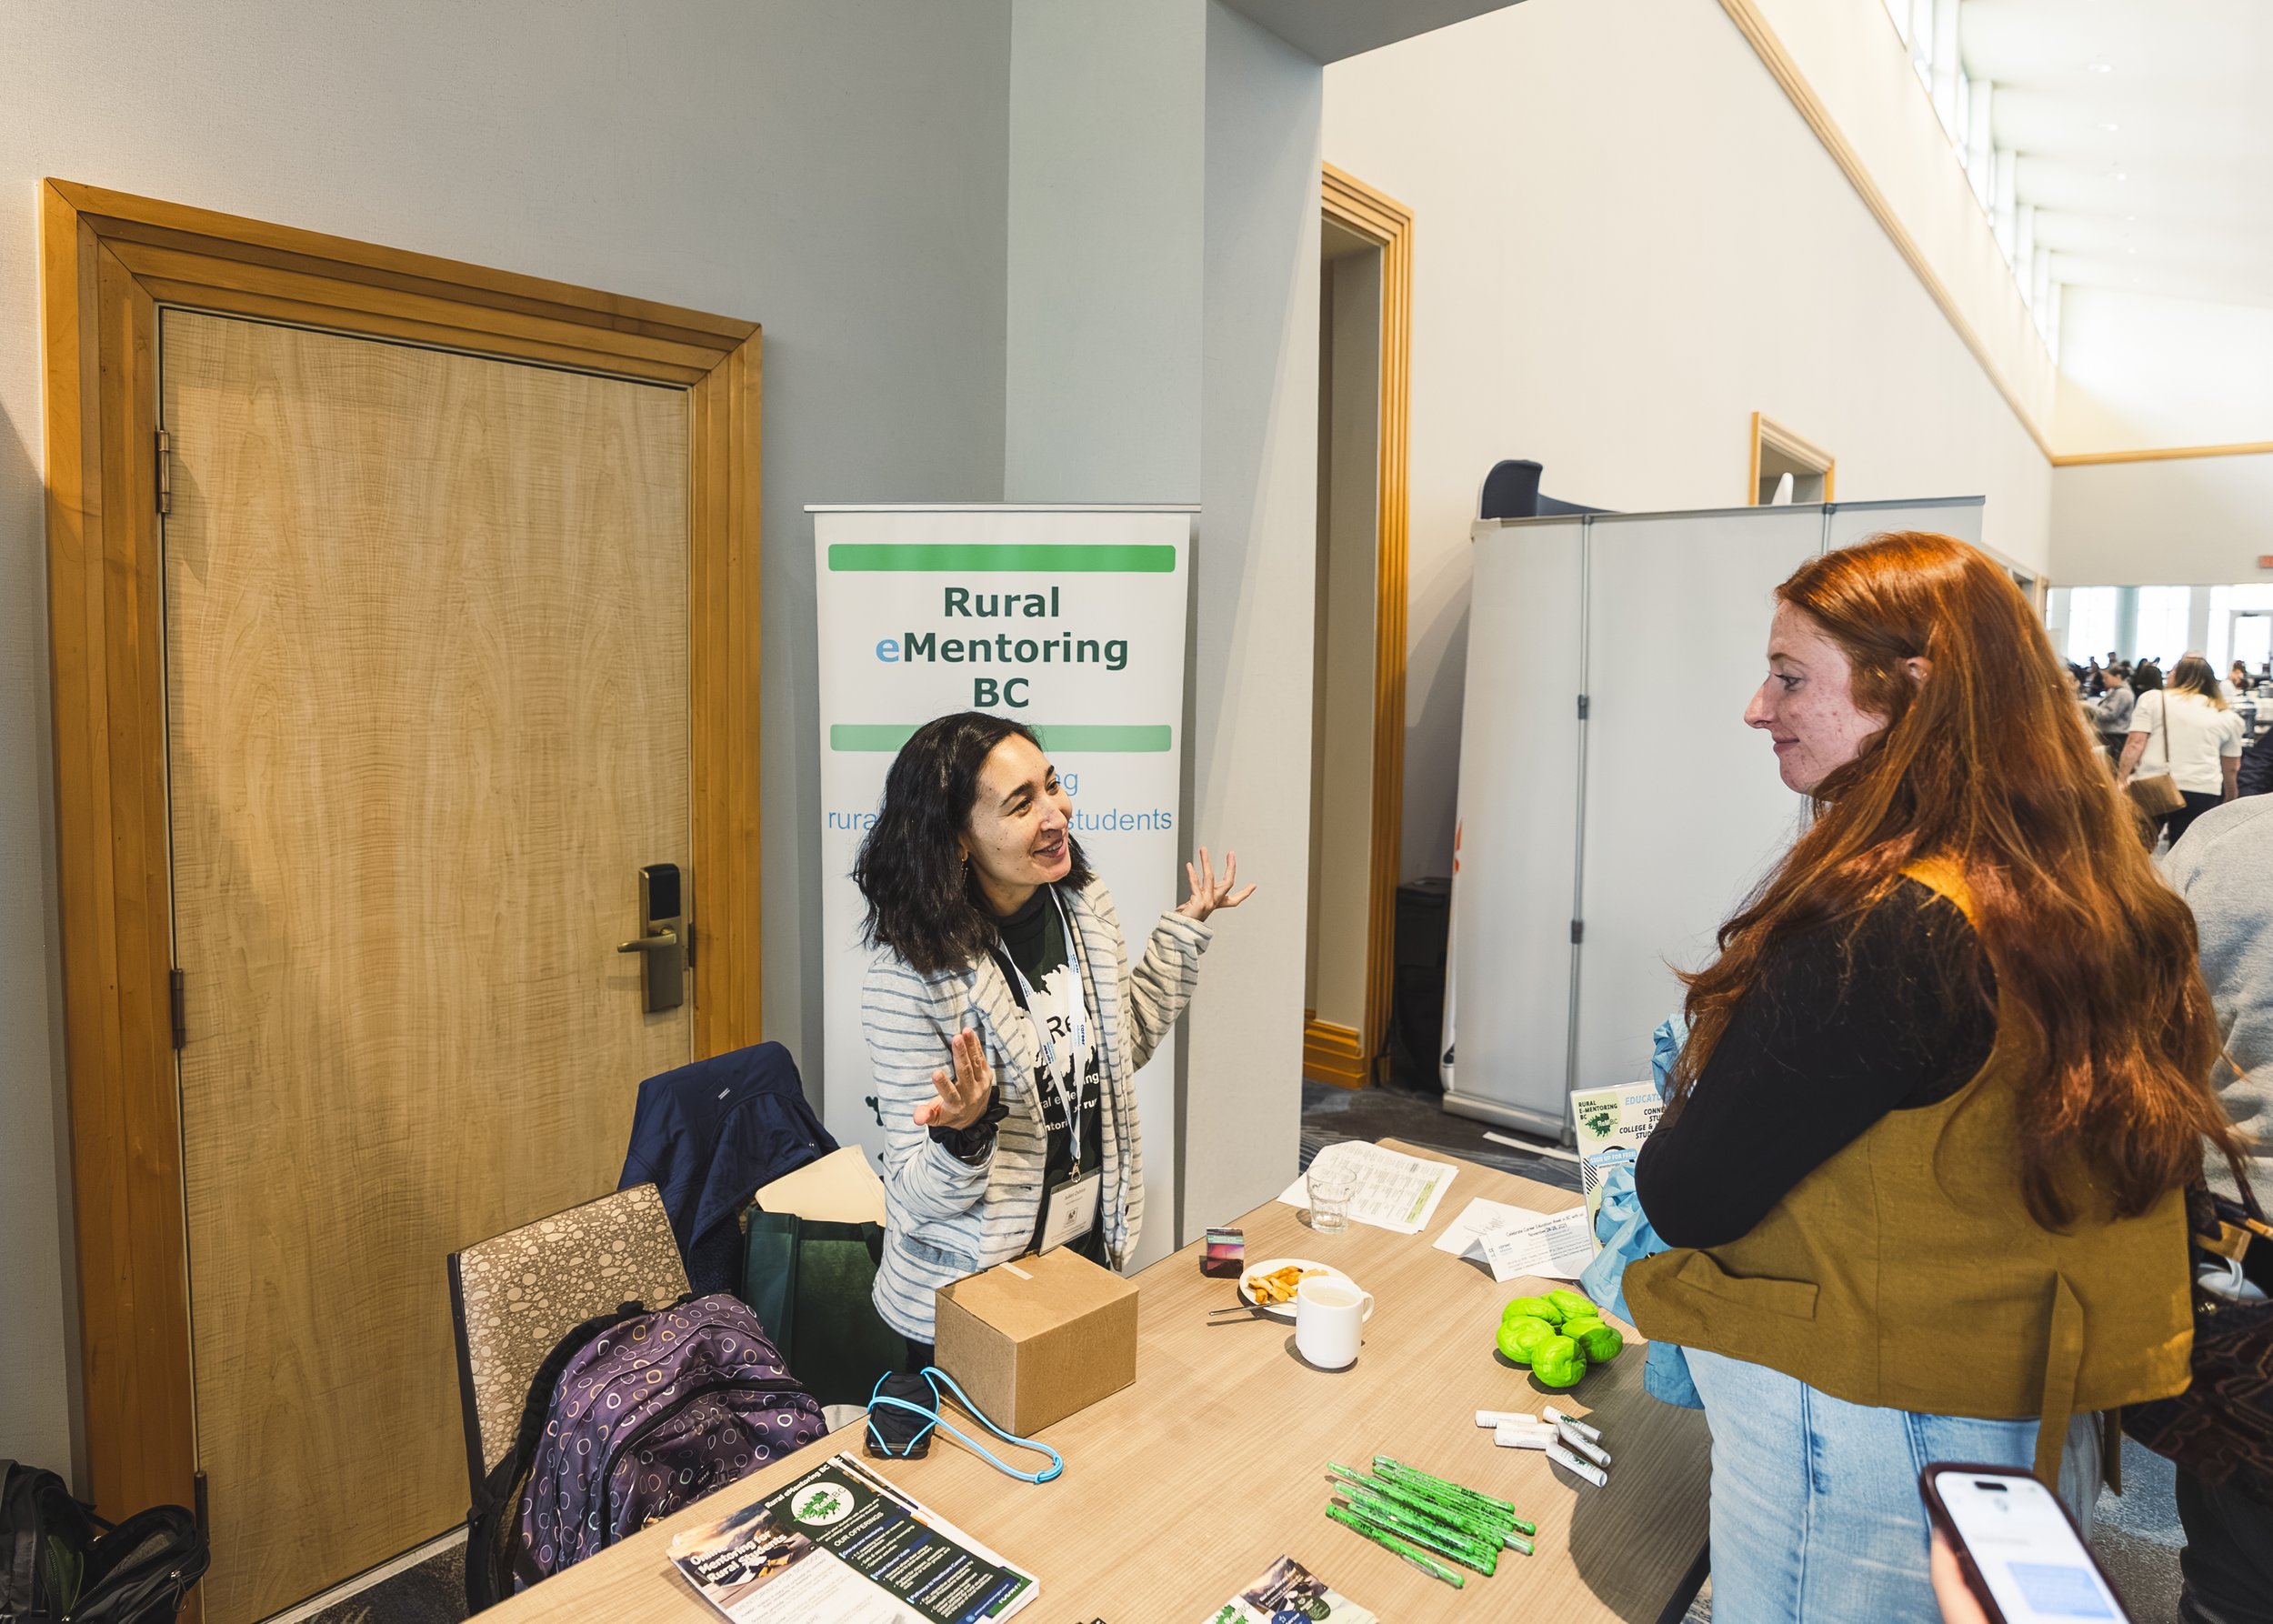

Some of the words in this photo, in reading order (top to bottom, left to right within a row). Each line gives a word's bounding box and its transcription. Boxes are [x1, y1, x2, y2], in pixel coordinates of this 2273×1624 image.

[944, 586, 1060, 617] Rural
[875, 631, 1128, 671] eMentoring
[973, 677, 1030, 708] BC
[828, 811, 878, 830] rura
[1619, 1124, 1647, 1134] COLLEGE
[834, 1534, 850, 1547] OUR
[848, 1511, 884, 1537] OFFERINGS
[697, 1540, 756, 1574] Mentoring
[754, 1530, 771, 1544] for
[706, 1560, 740, 1582] Rural
